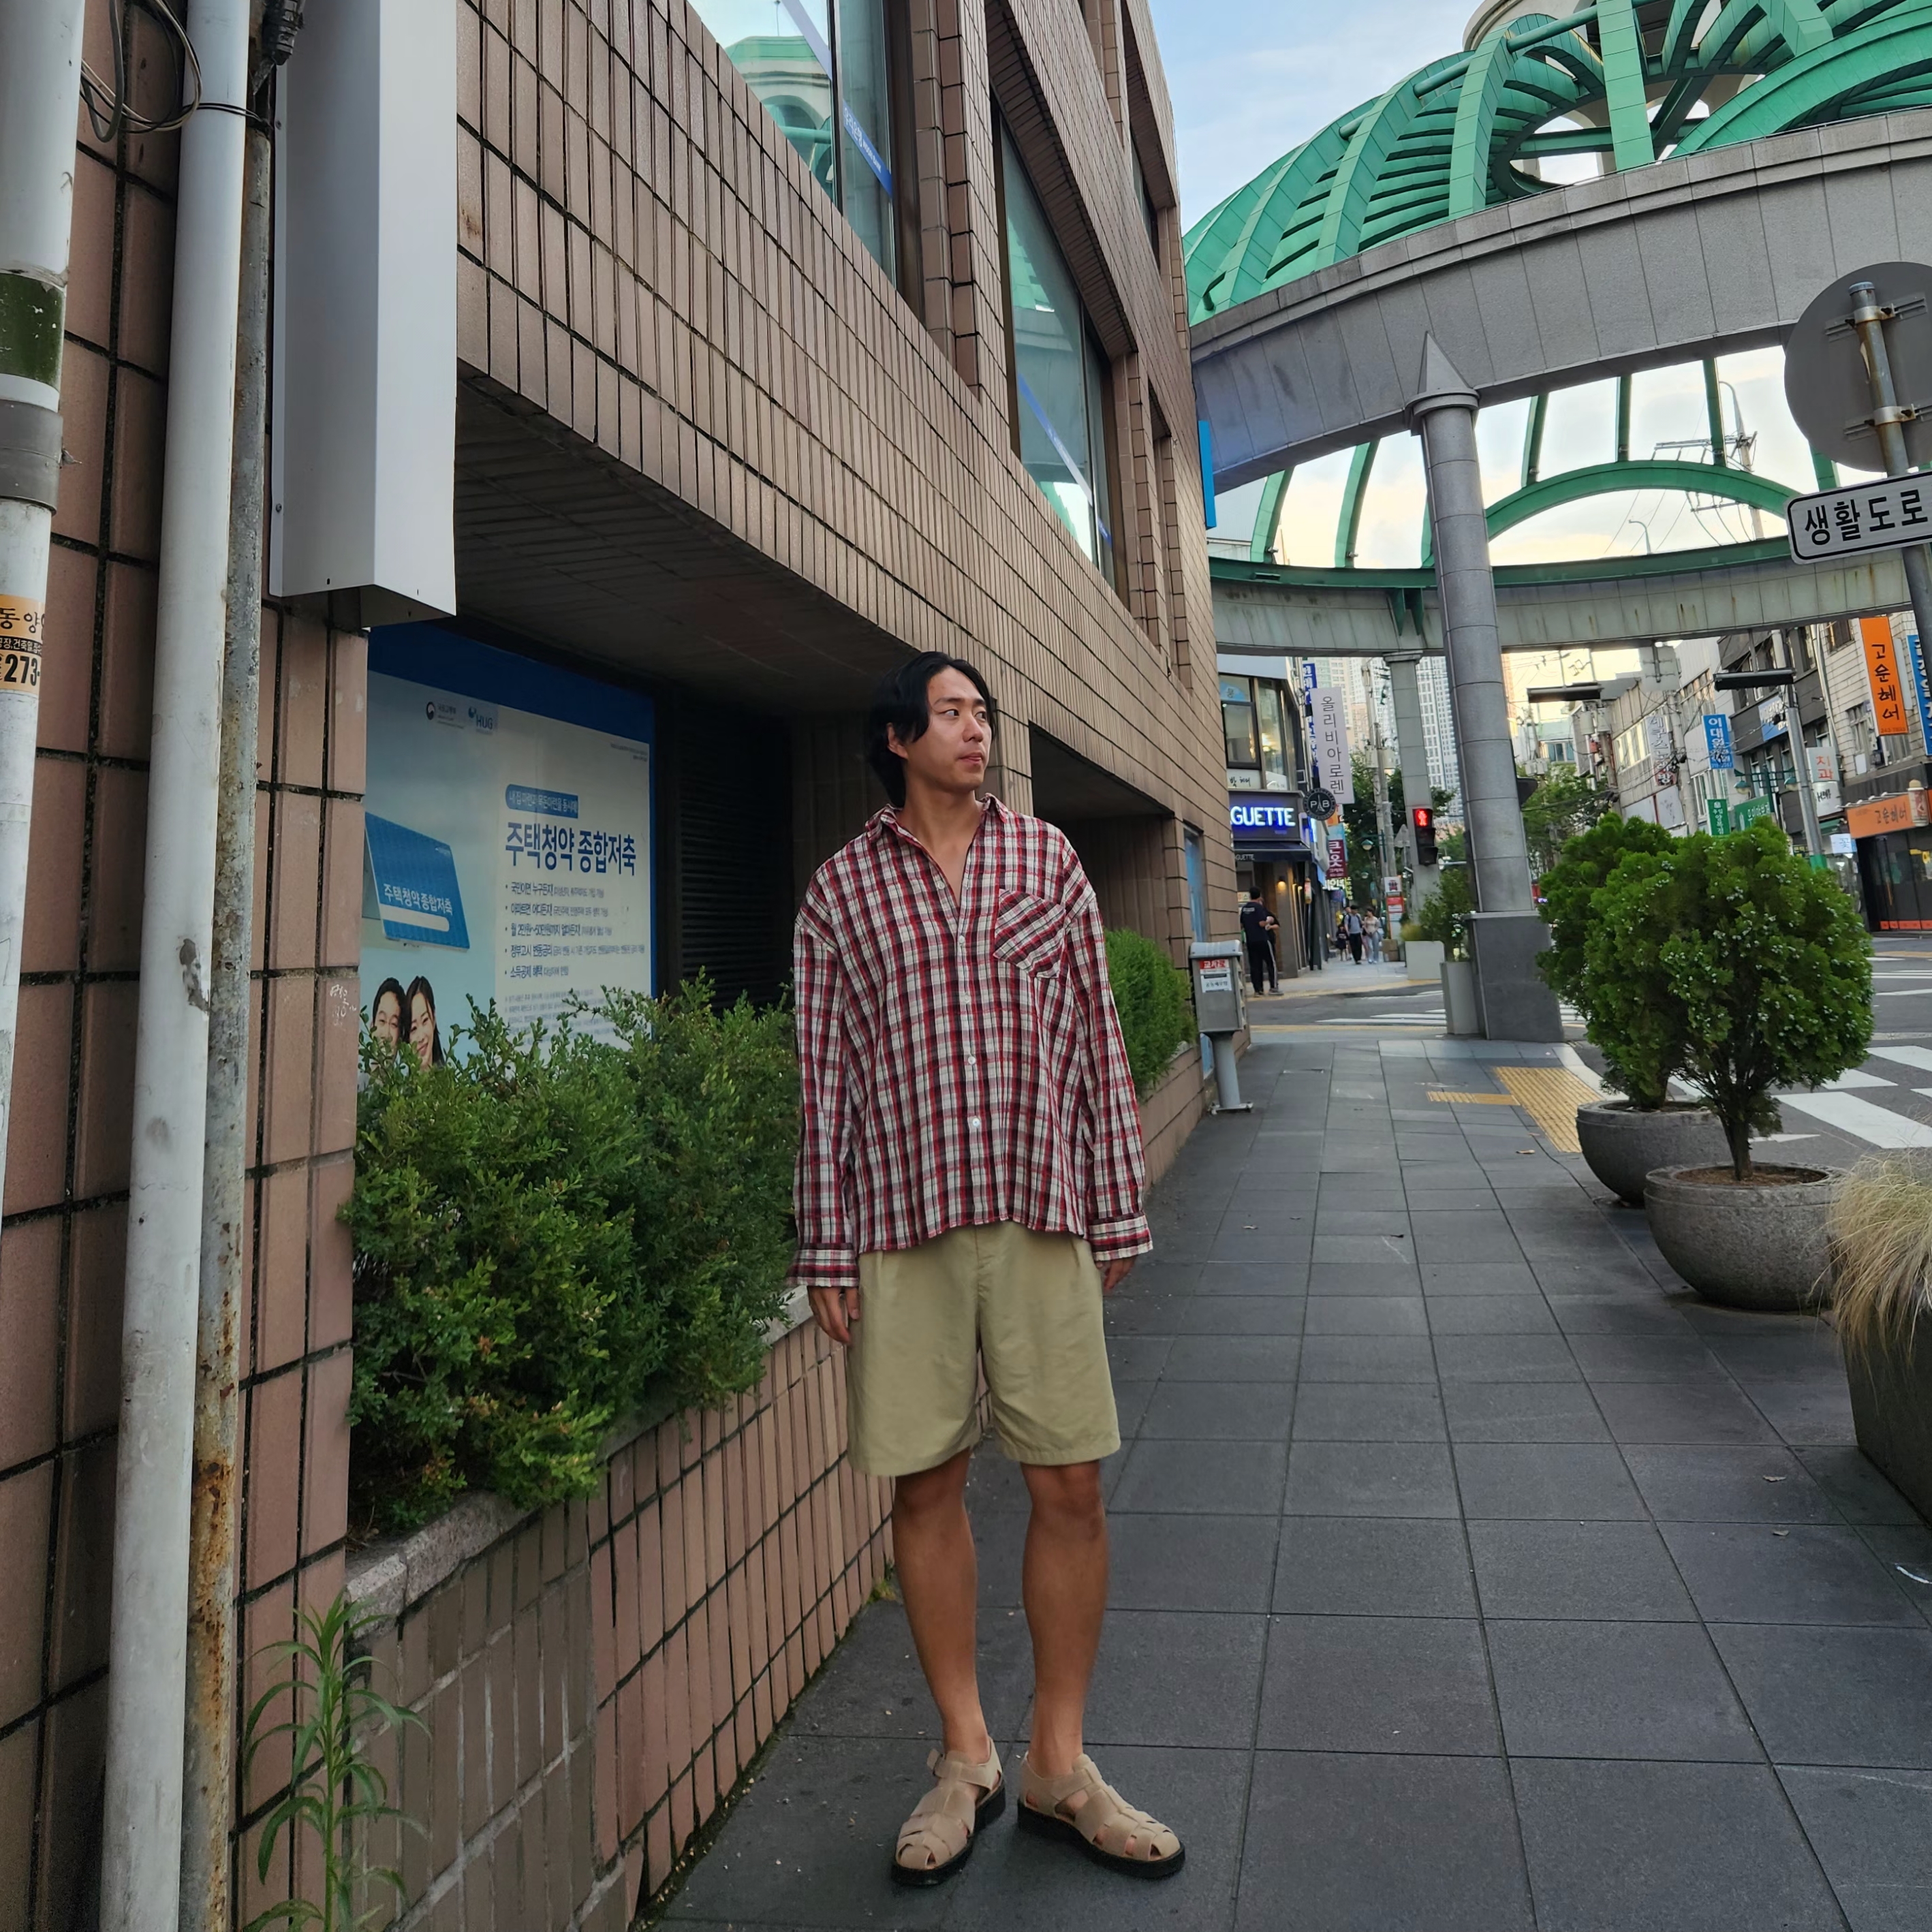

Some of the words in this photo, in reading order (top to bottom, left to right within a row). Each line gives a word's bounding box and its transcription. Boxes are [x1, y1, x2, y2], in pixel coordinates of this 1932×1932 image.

[1805, 489, 1928, 546] 생활도로
[476, 715, 493, 730] HUG
[1321, 696, 1344, 795] 올리비아로렌
[1816, 755, 1834, 779] 치과
[1230, 805, 1296, 826] GUETTE
[505, 822, 575, 871] 주택청약
[578, 829, 636, 876] 종합저축
[1328, 841, 1343, 868] 큰옷
[1839, 837, 1850, 848] 꽃
